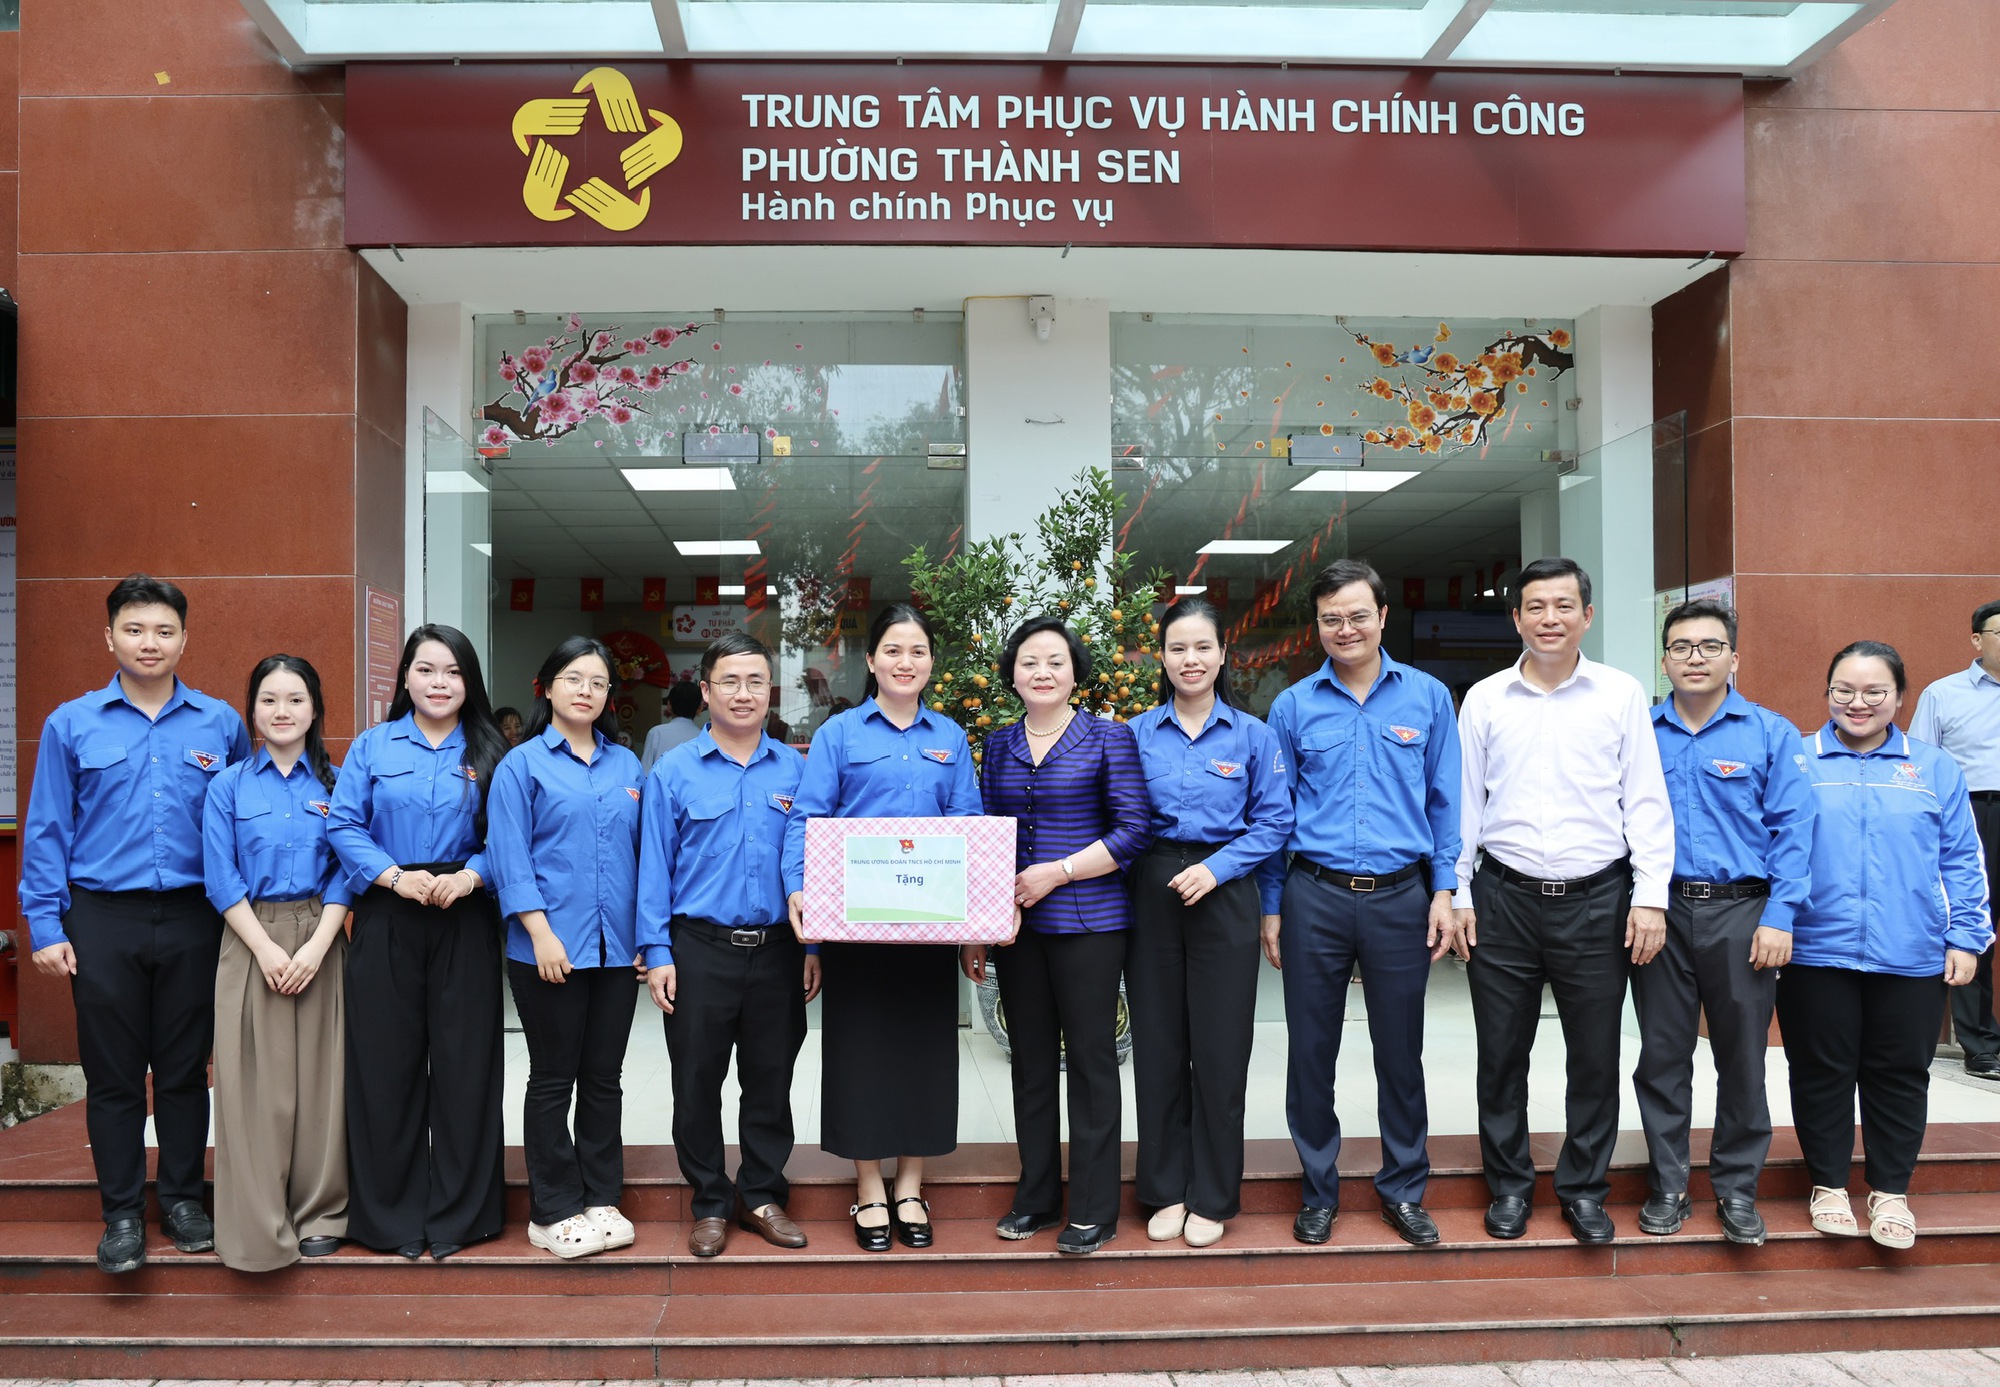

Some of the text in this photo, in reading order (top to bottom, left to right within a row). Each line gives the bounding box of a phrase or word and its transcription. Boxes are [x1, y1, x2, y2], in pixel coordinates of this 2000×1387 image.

[742, 86, 1585, 139] TRUNG TÂM PHỤC VỤ HÀNH CHÍNH CÔNG
[742, 139, 1180, 184] PHƯỜNG THÀNH SEN
[742, 190, 1113, 228] Hành chính Phục vụ
[896, 874, 924, 886] Tặng
